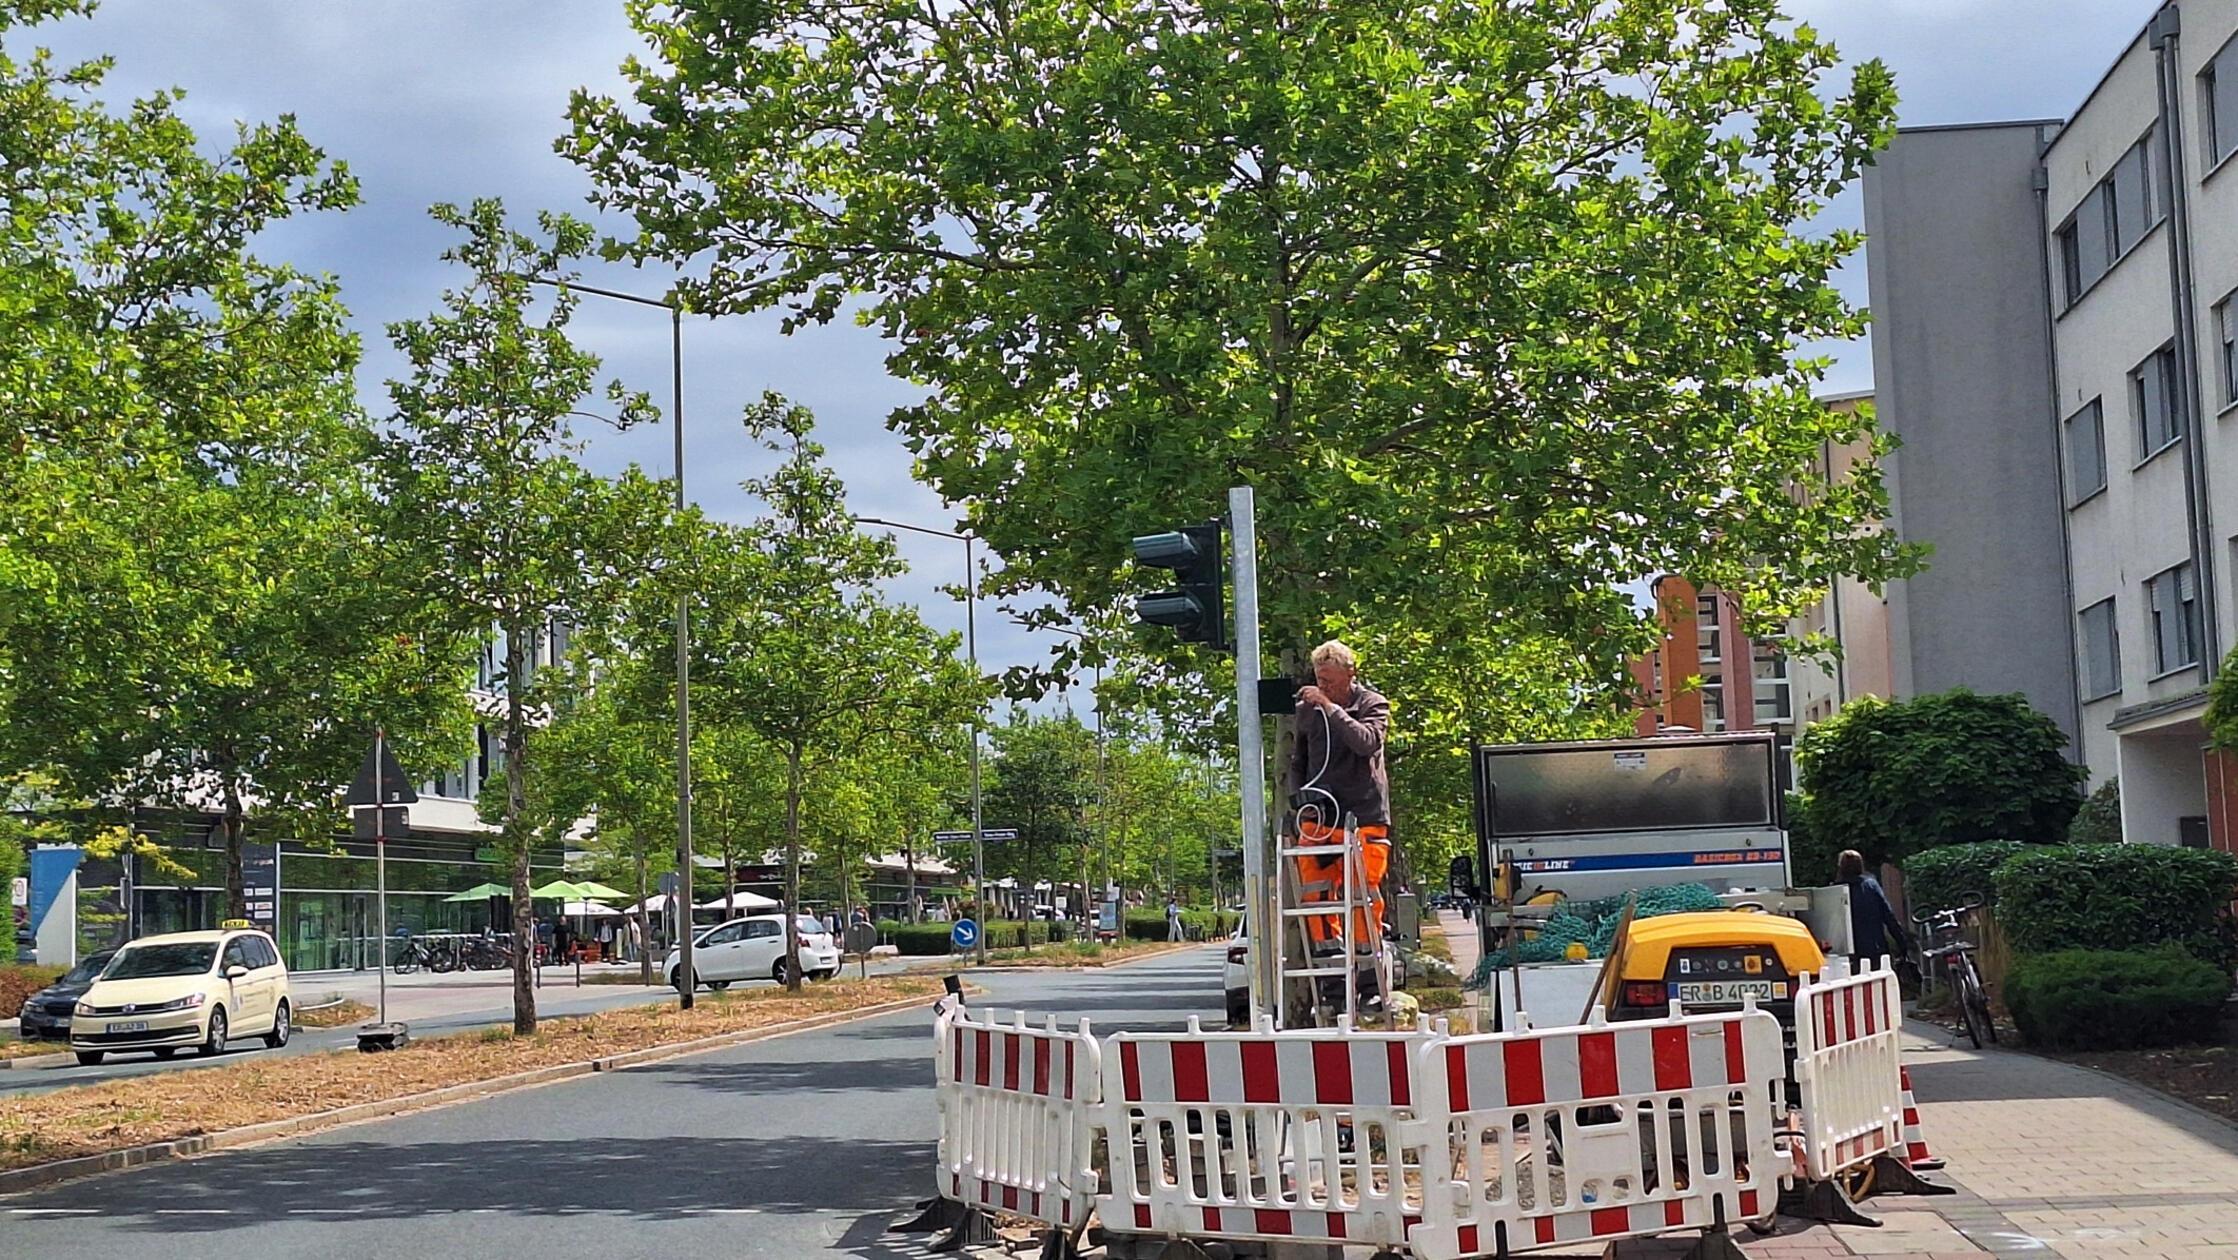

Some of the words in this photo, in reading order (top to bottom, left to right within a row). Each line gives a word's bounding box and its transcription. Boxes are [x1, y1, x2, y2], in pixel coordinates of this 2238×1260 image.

[1544, 860, 1569, 870] LINE
[1680, 985, 1701, 1002] ER
[1713, 984, 1724, 1000] B
